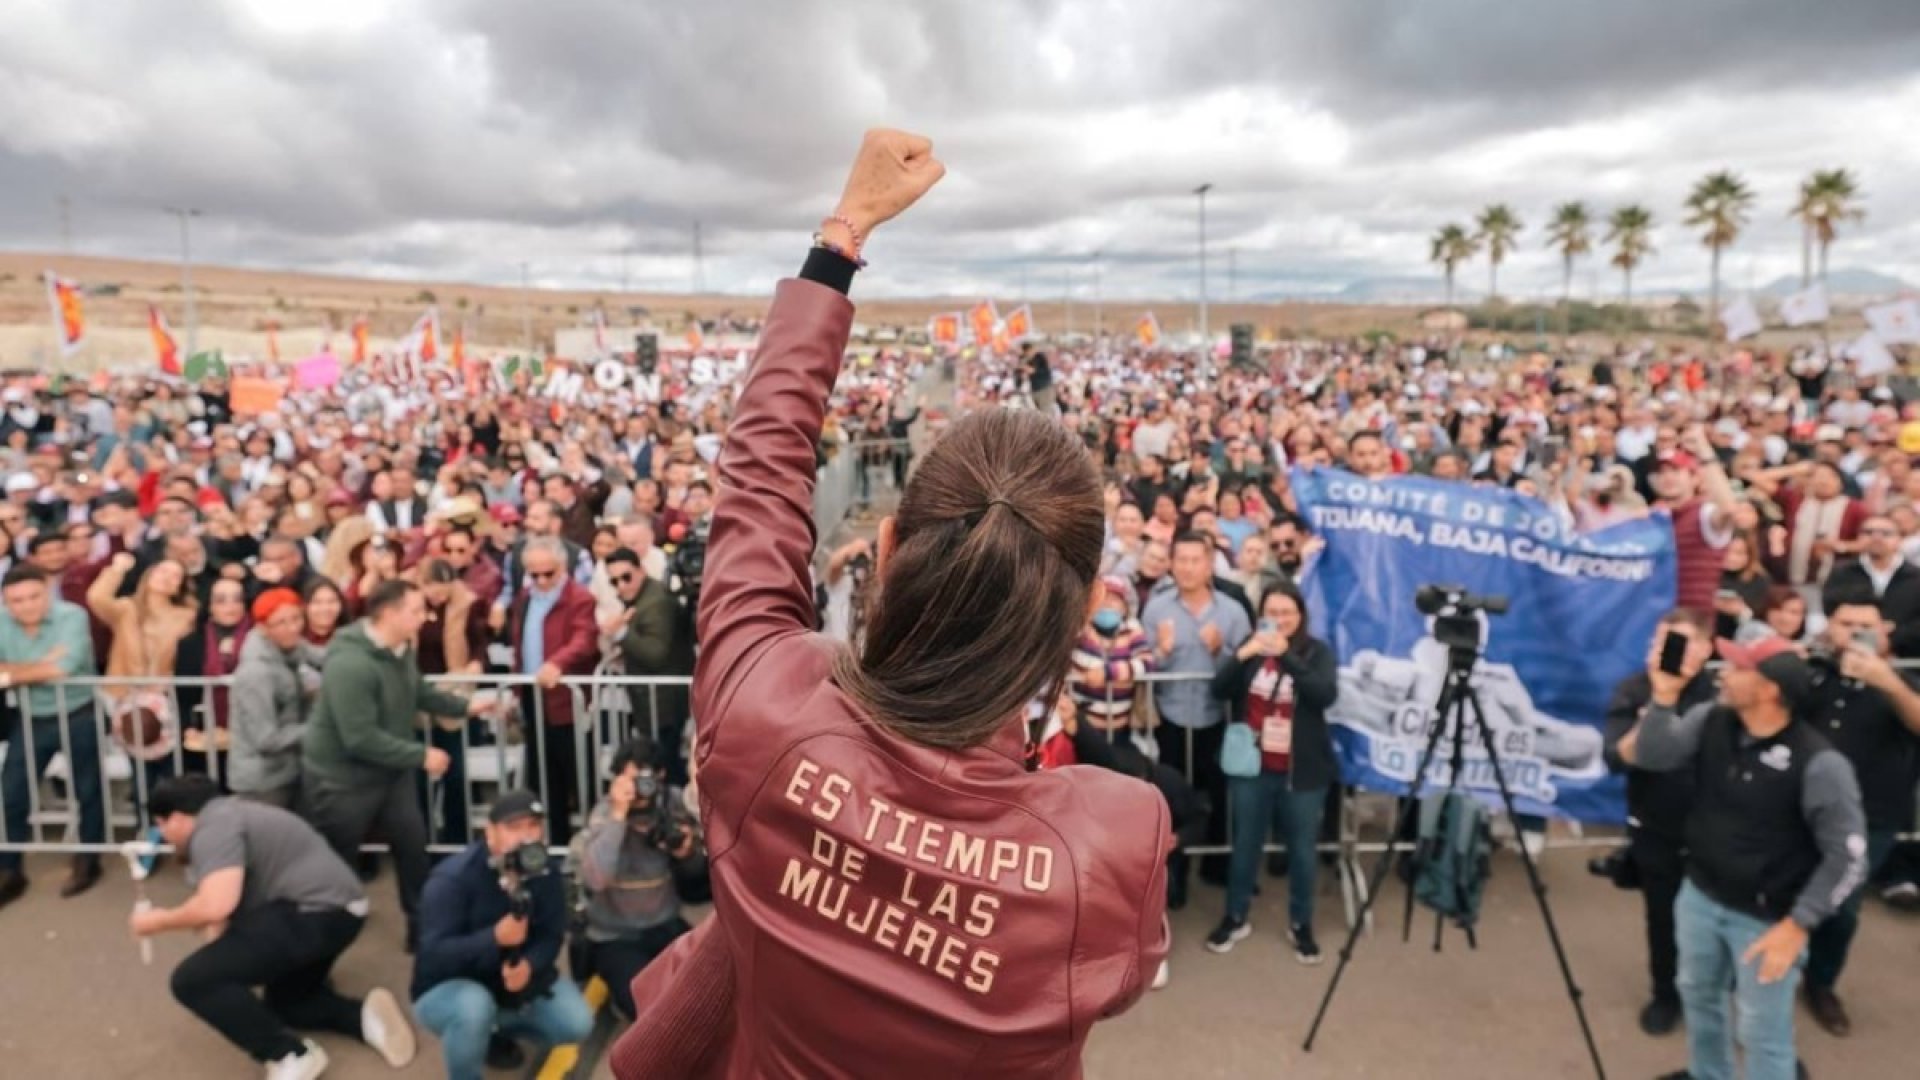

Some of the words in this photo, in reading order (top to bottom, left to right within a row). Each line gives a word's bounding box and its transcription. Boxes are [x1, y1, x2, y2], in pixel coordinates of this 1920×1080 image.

[1327, 480, 1447, 516] COMITÉ
[1463, 499, 1507, 524] DE
[1430, 523, 1506, 557] BAJA
[1504, 729, 1528, 754] es
[785, 759, 852, 822] ES
[864, 797, 1053, 892] TIEMPO
[811, 829, 867, 883] DE
[900, 868, 1000, 938] LAS
[778, 858, 1000, 994] MUJERES
